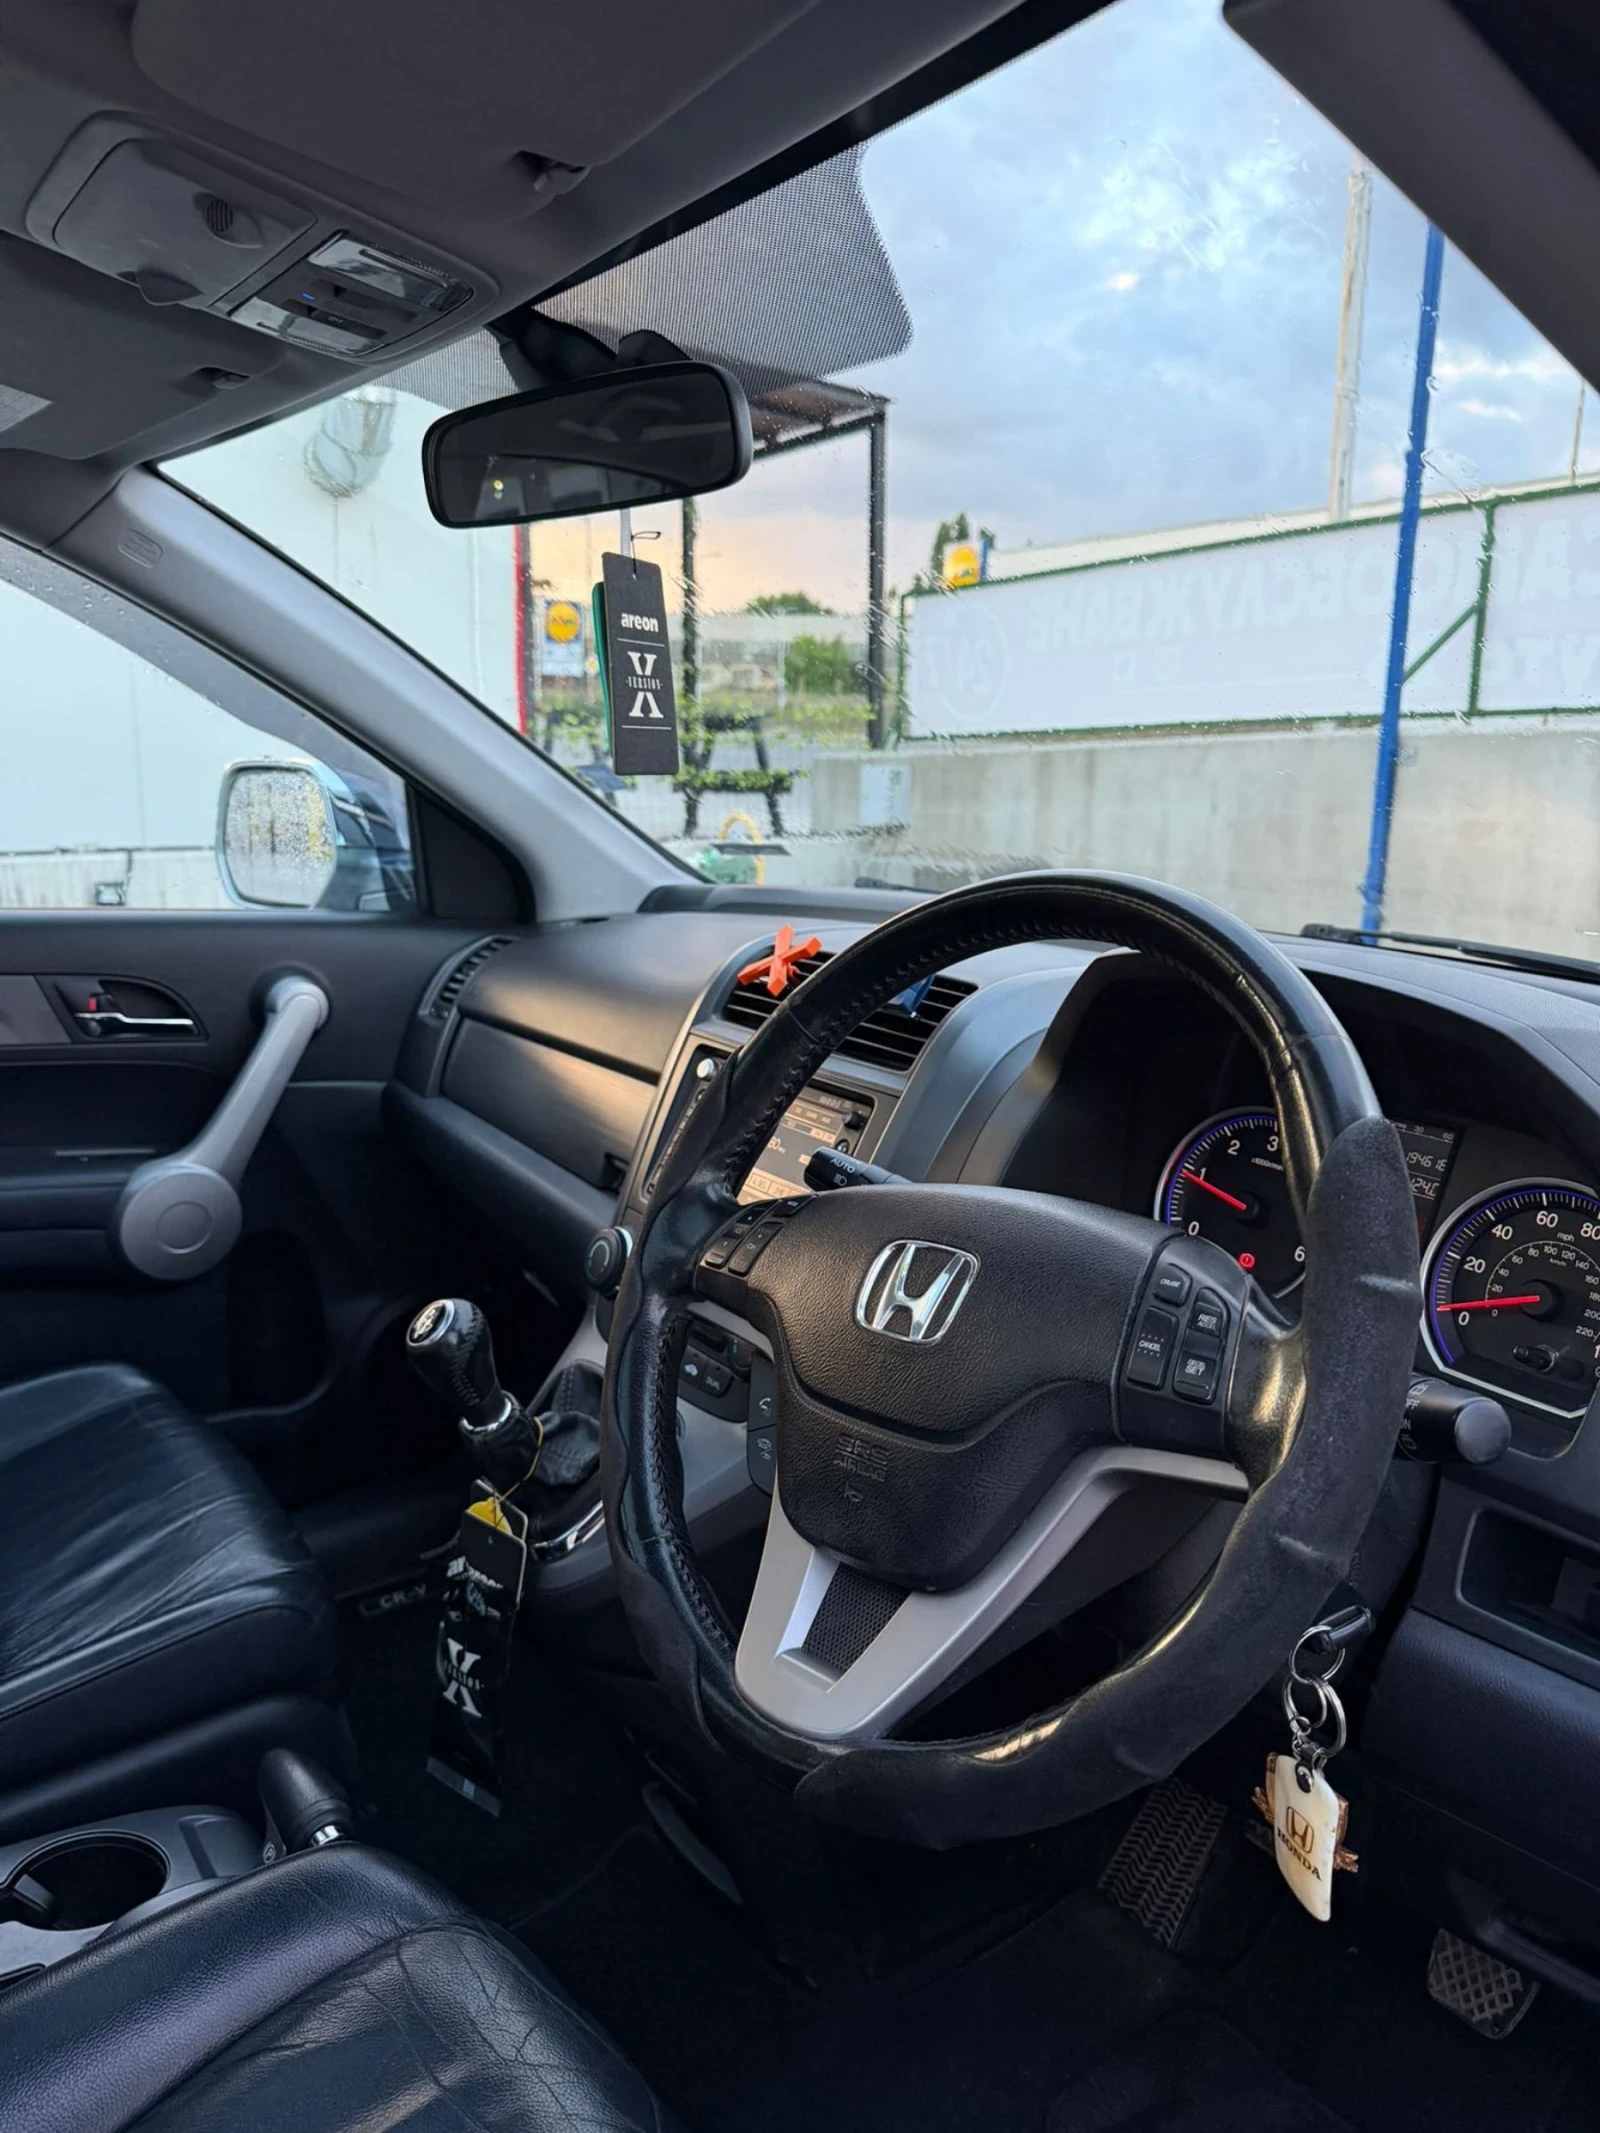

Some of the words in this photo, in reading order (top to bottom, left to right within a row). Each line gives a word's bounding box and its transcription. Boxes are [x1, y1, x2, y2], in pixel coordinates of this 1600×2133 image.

[621, 612, 659, 633] areon
[1227, 1140, 1241, 1156] 2
[1266, 1135, 1279, 1152] 3
[830, 1157, 856, 1174] AUTO
[1198, 1167, 1207, 1180] 1
[1536, 1210, 1559, 1228] 60
[1188, 1221, 1200, 1236] 0
[1491, 1223, 1513, 1240] 40
[1580, 1222, 1600, 1240] 80
[1556, 1232, 1575, 1243] mph
[1294, 1246, 1306, 1263] 6
[1527, 1247, 1540, 1258] 80
[1543, 1245, 1558, 1255] 100
[1561, 1250, 1576, 1261] 120
[1463, 1256, 1486, 1274] 20
[1511, 1255, 1524, 1265] 60
[1575, 1260, 1590, 1271] 140
[1498, 1268, 1510, 1278] 40
[1585, 1274, 1600, 1286] 160
[1491, 1284, 1503, 1294] 20
[1198, 1313, 1218, 1324] RES
[1458, 1311, 1471, 1326] 0
[1491, 1308, 1499, 1318] 0
[1575, 1325, 1594, 1338] 220
[1138, 1339, 1161, 1352] CANCEL
[1185, 1364, 1206, 1376] SET
[380, 1583, 427, 1610] CR-V
[1277, 1826, 1323, 1882] HONDA
